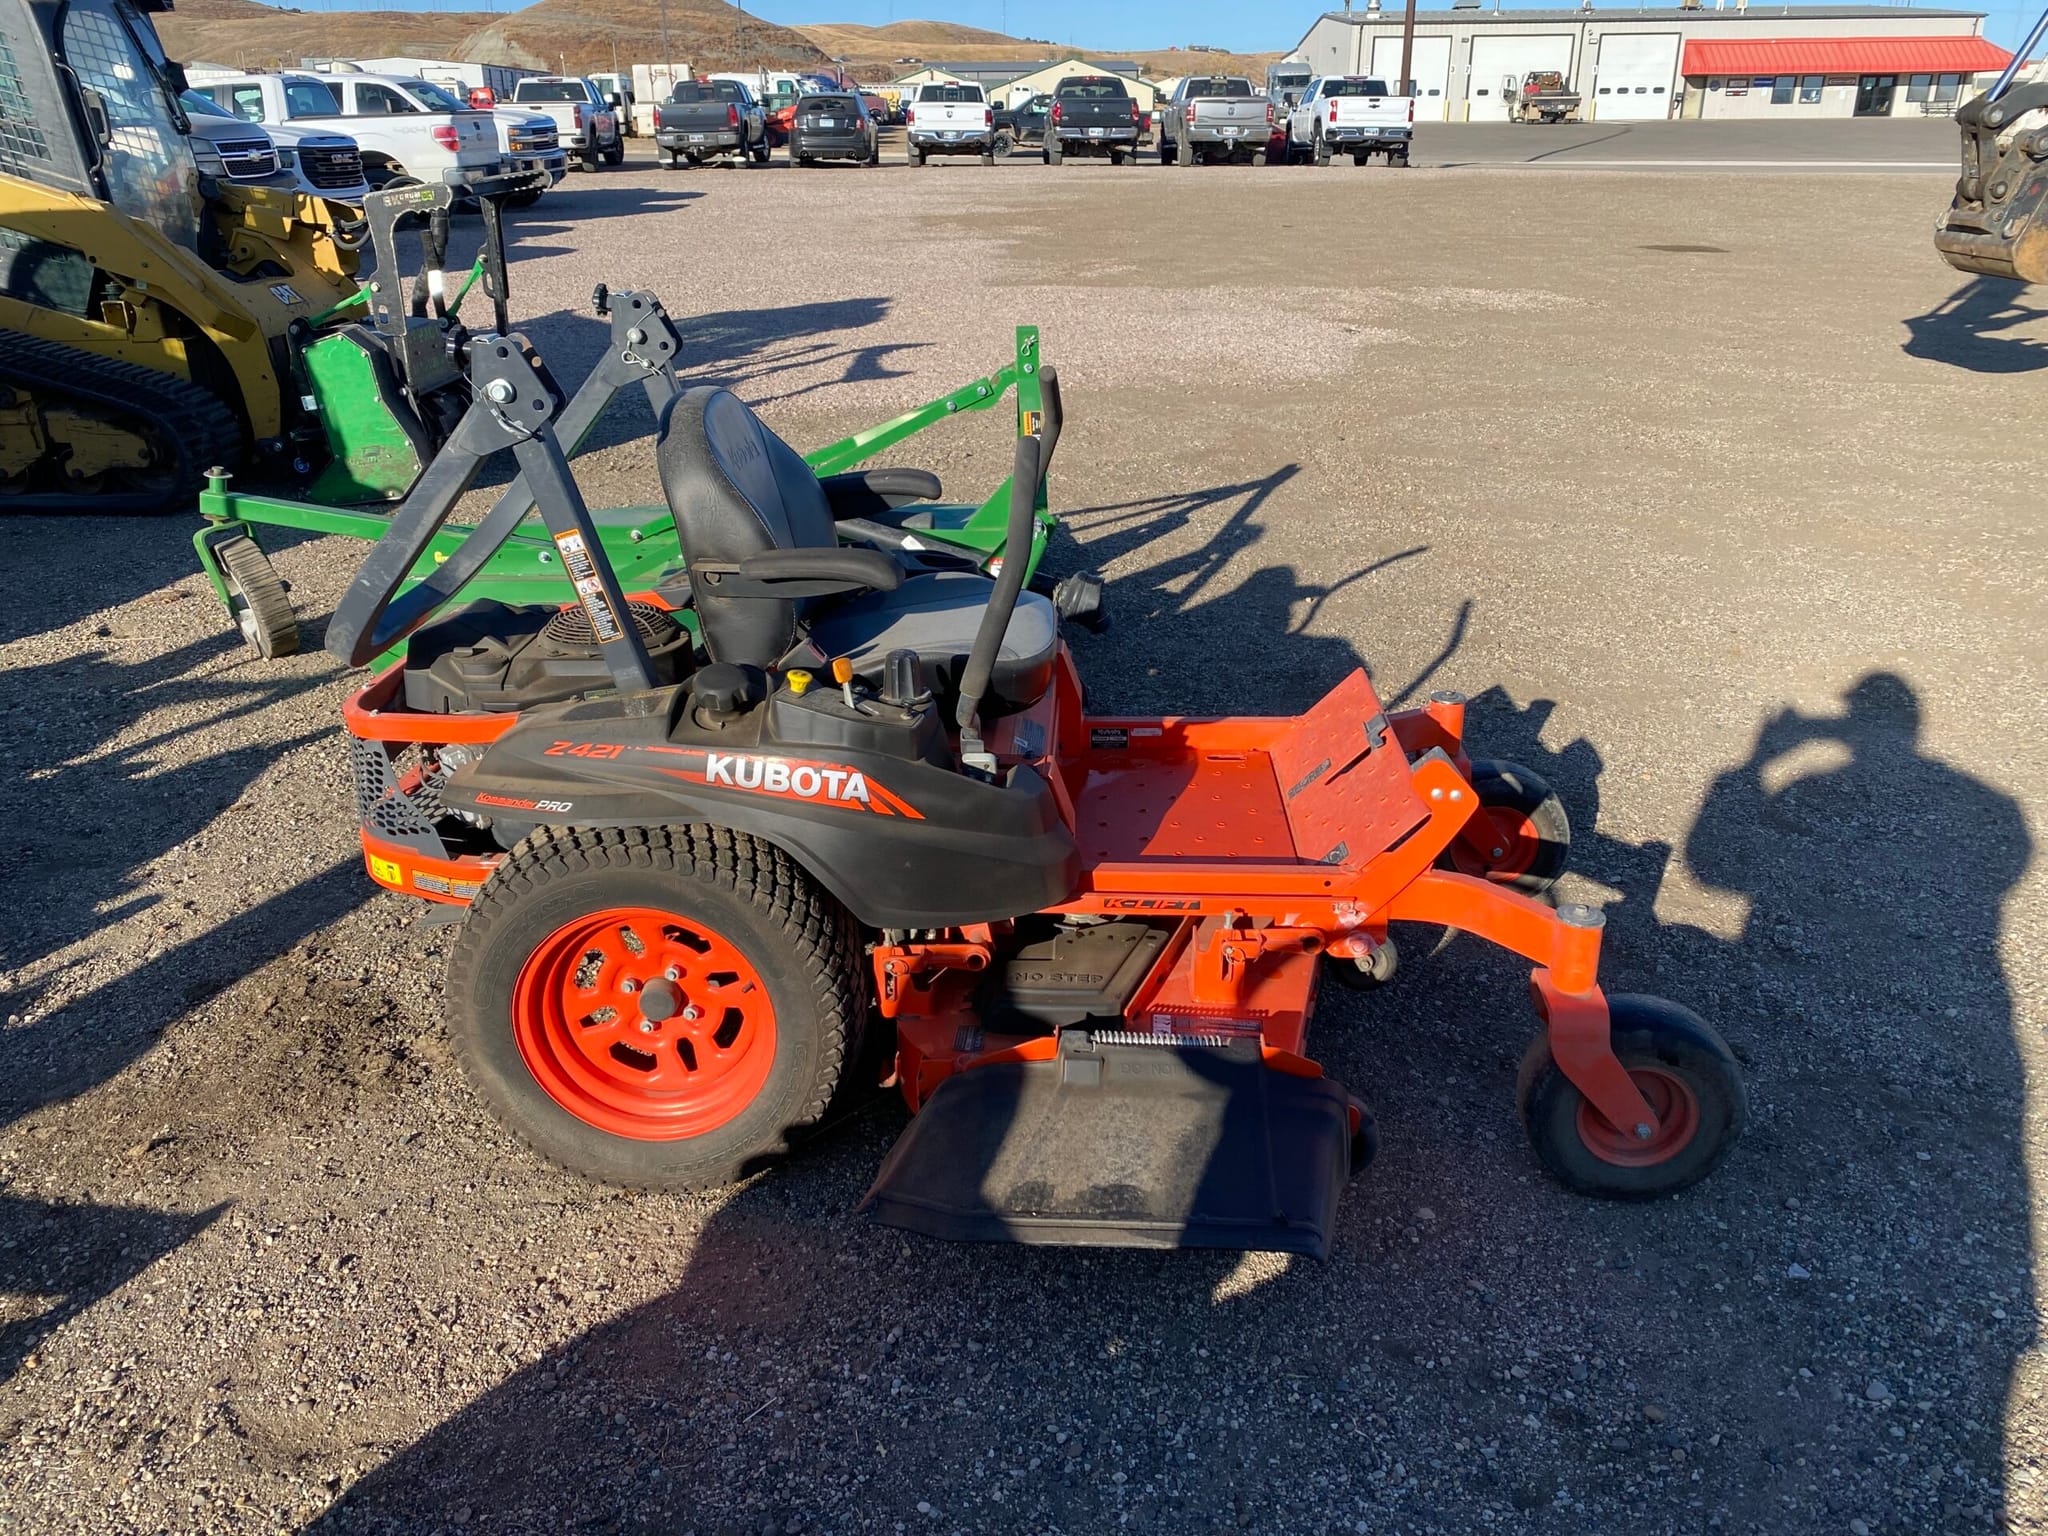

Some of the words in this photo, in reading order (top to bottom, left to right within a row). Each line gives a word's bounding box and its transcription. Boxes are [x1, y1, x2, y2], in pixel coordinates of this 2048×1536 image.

[269, 284, 303, 305] CAT
[546, 741, 624, 759] Z421
[706, 754, 870, 803] KUBOTA
[534, 800, 573, 812] PRO
[1106, 899, 1199, 909] K-LIFT
[1015, 972, 1043, 982] NO
[1051, 972, 1104, 984] STEP
